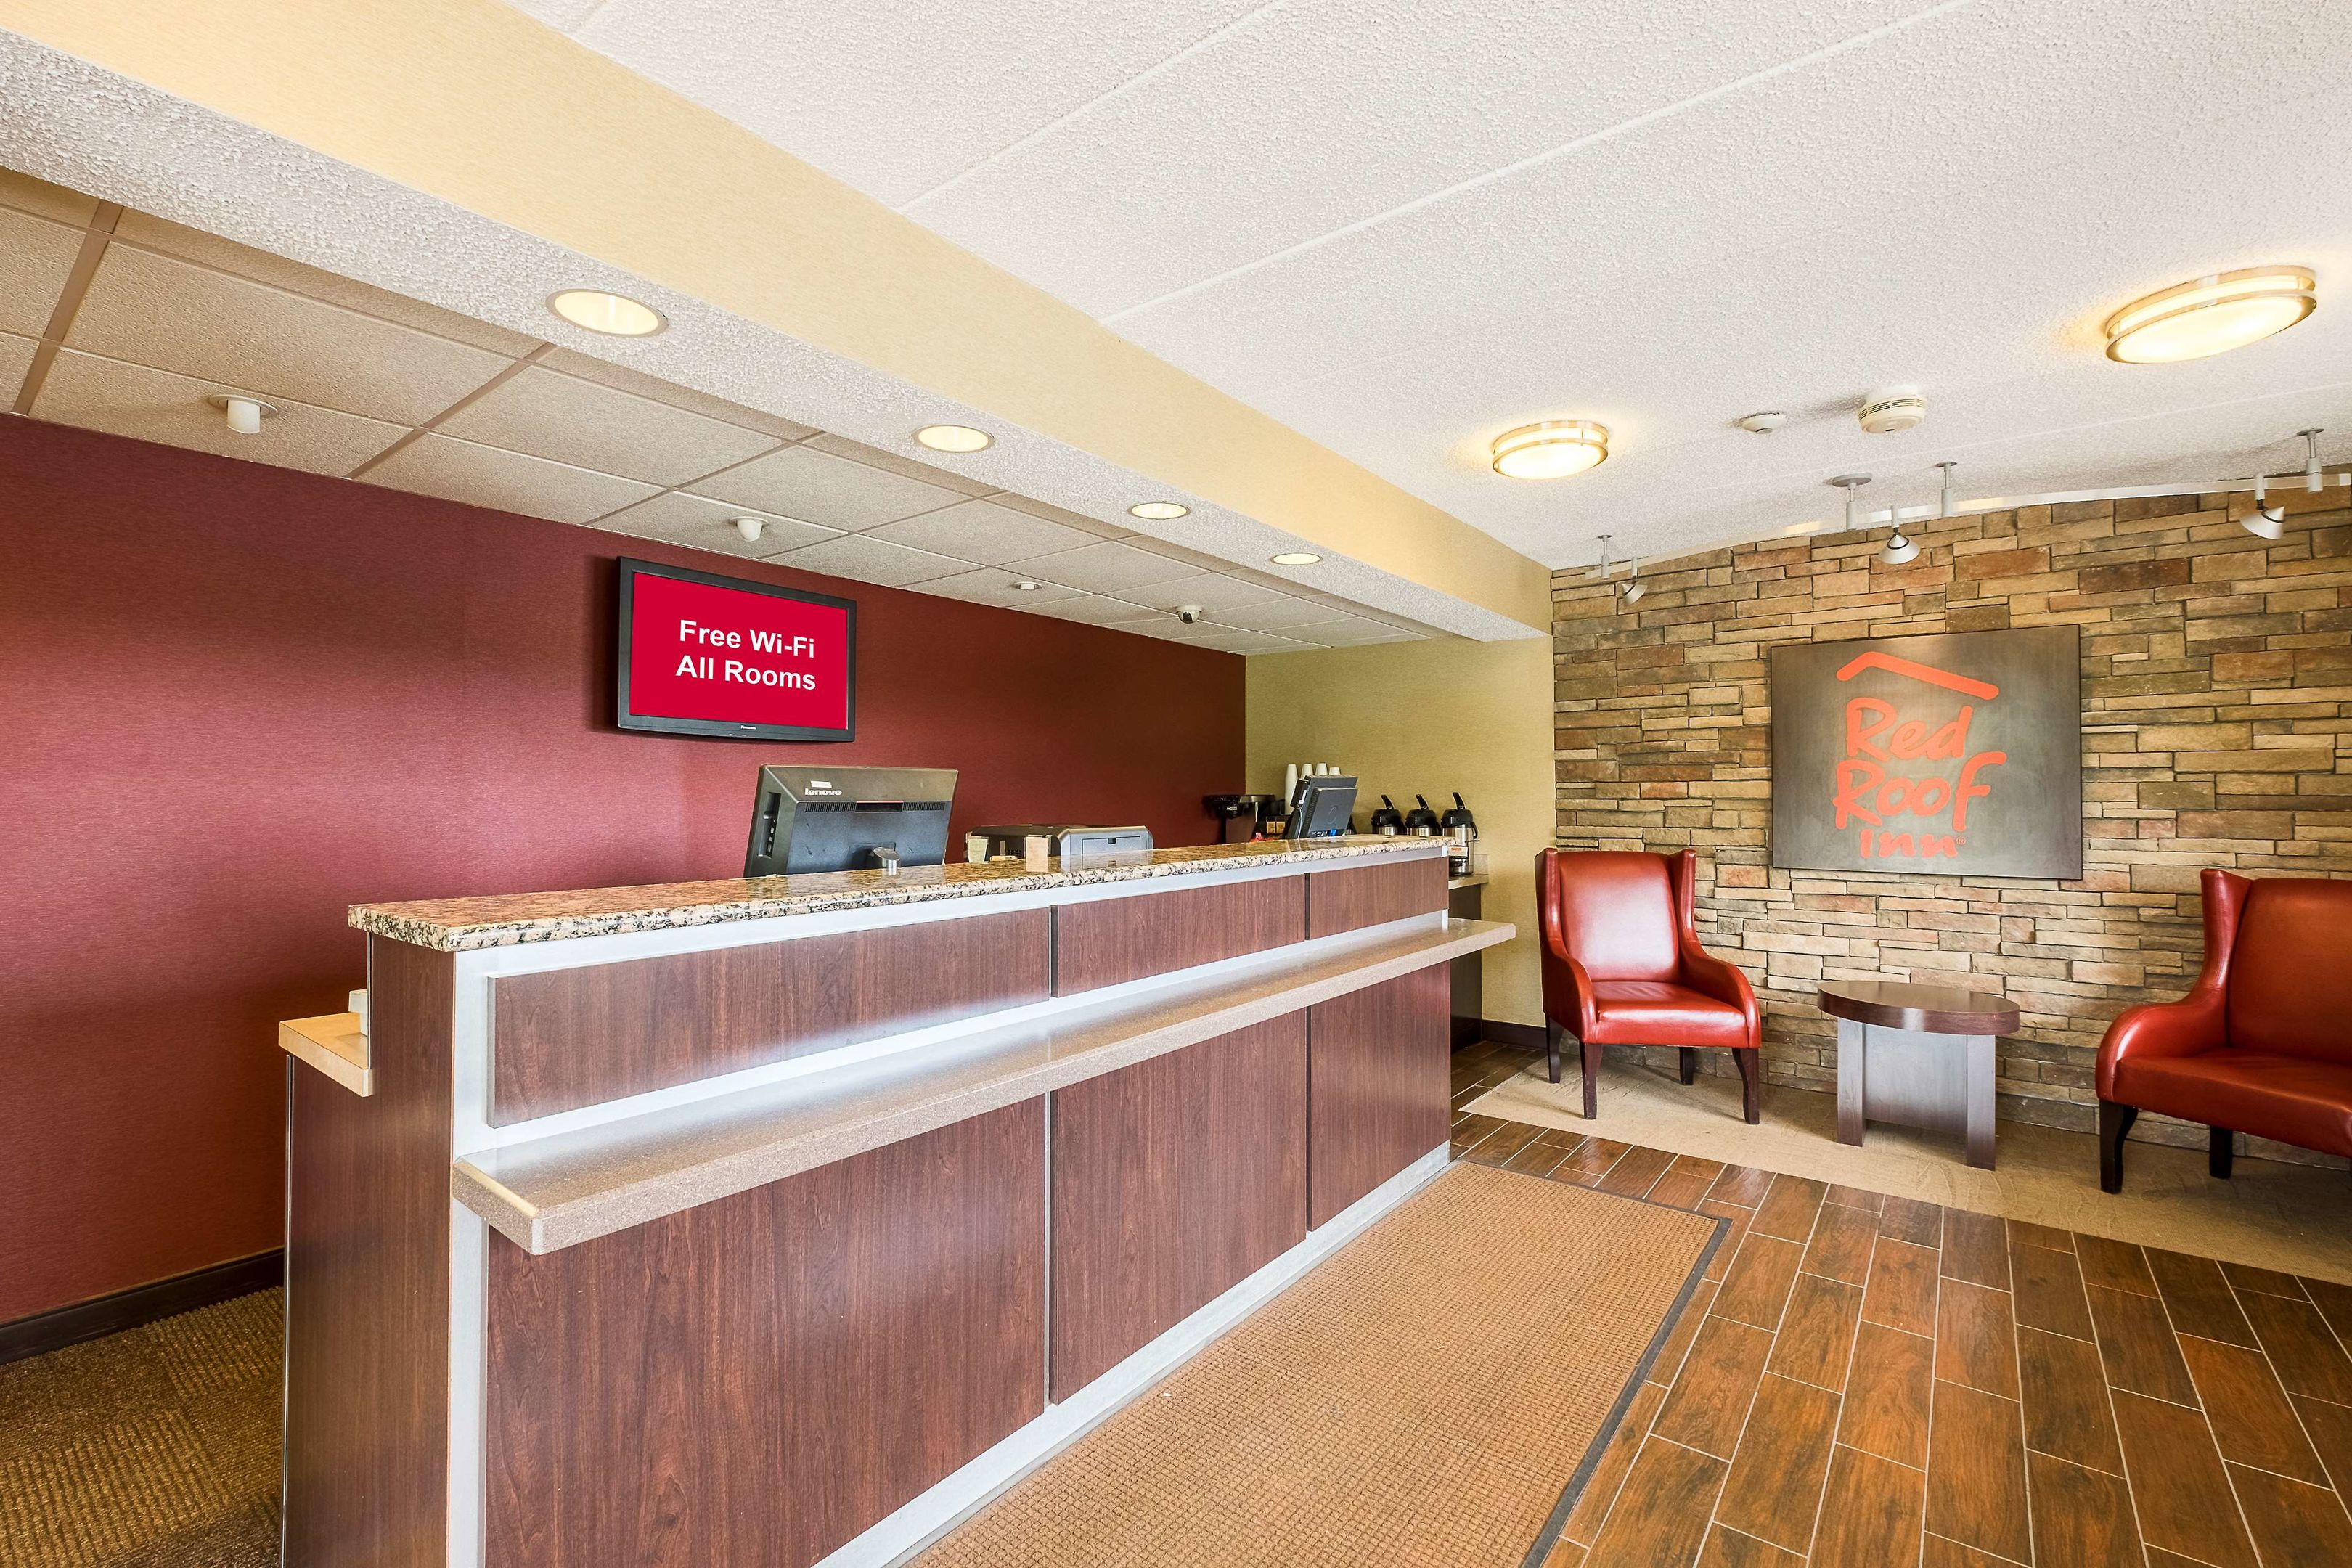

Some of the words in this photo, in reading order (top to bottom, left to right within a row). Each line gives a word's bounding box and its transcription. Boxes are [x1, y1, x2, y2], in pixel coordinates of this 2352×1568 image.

[679, 619, 741, 649] Free
[750, 629, 814, 658] Wi-Fi
[676, 655, 714, 680] All
[724, 659, 816, 690] Rooms
[1846, 697, 1973, 762] Red
[1832, 751, 2007, 832] Roof
